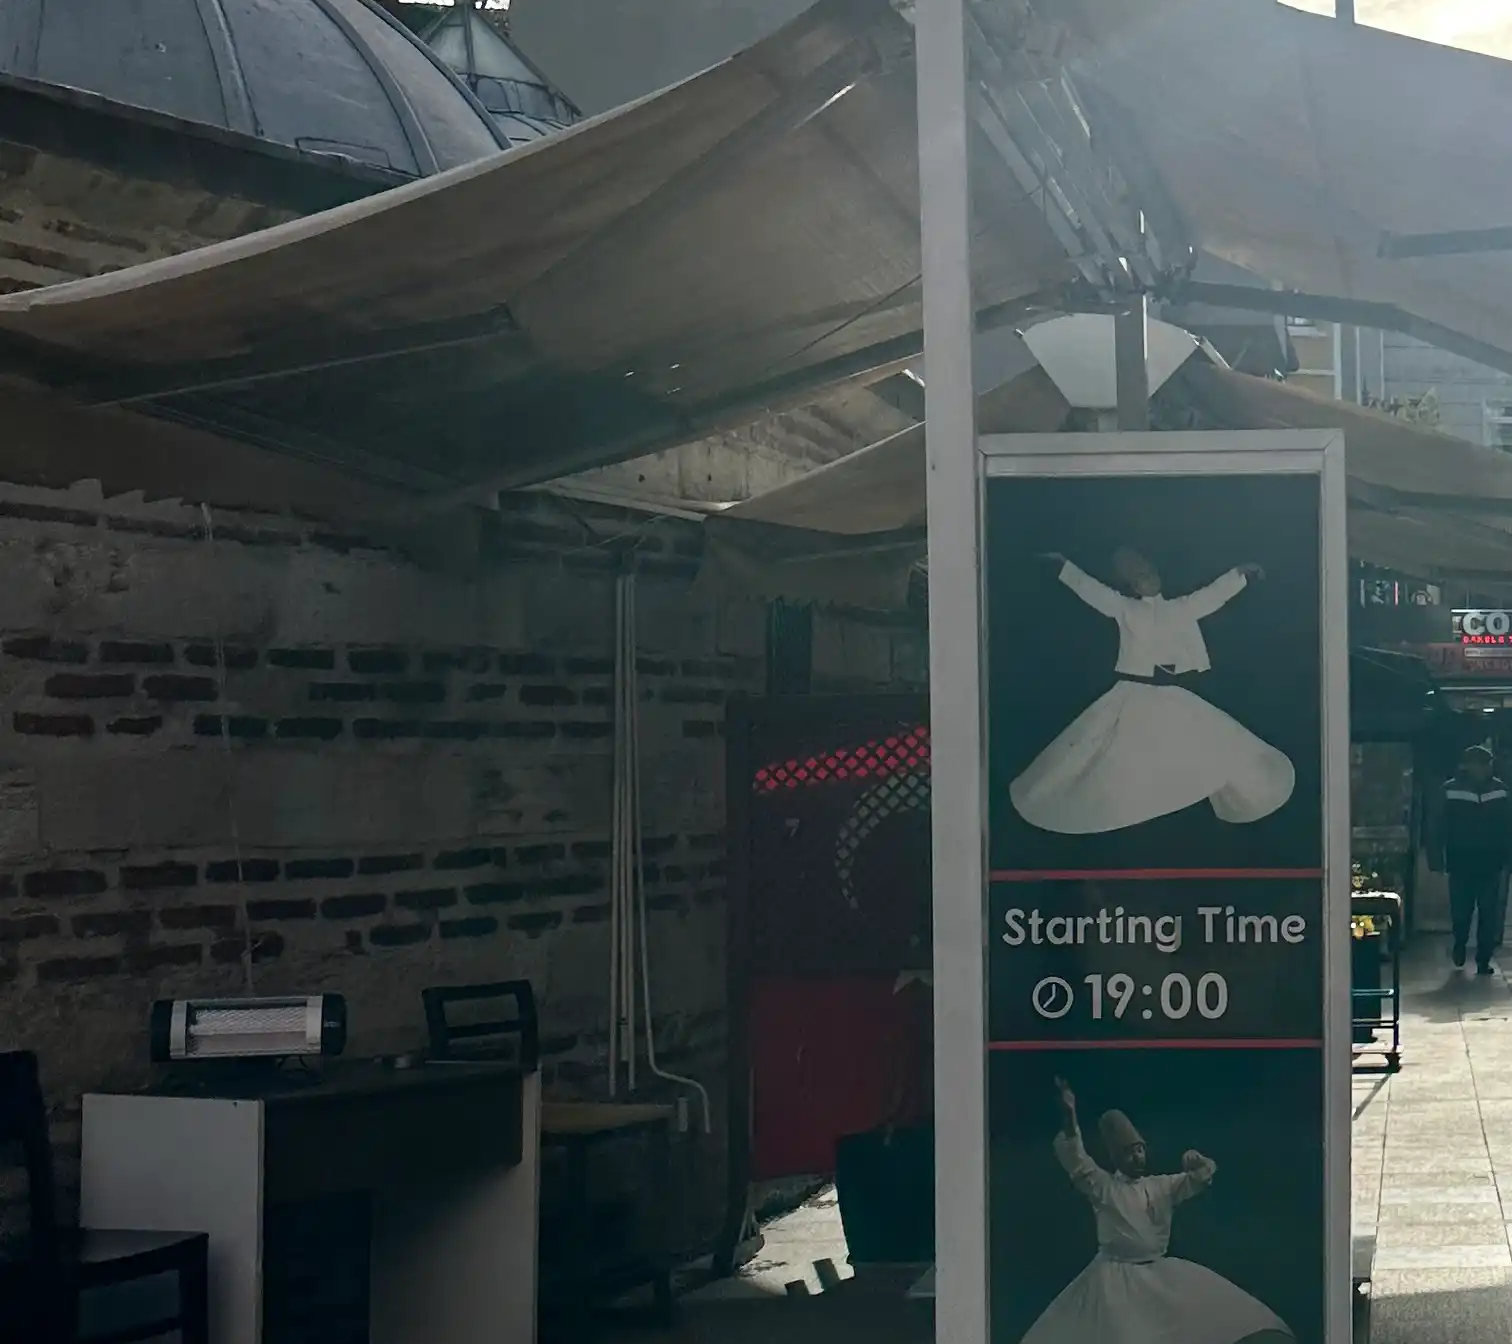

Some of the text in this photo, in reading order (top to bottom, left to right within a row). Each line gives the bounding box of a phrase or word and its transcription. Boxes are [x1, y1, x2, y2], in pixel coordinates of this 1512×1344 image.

[1002, 905, 1307, 953] Starting Time
[1084, 972, 1229, 1020] 19:00
